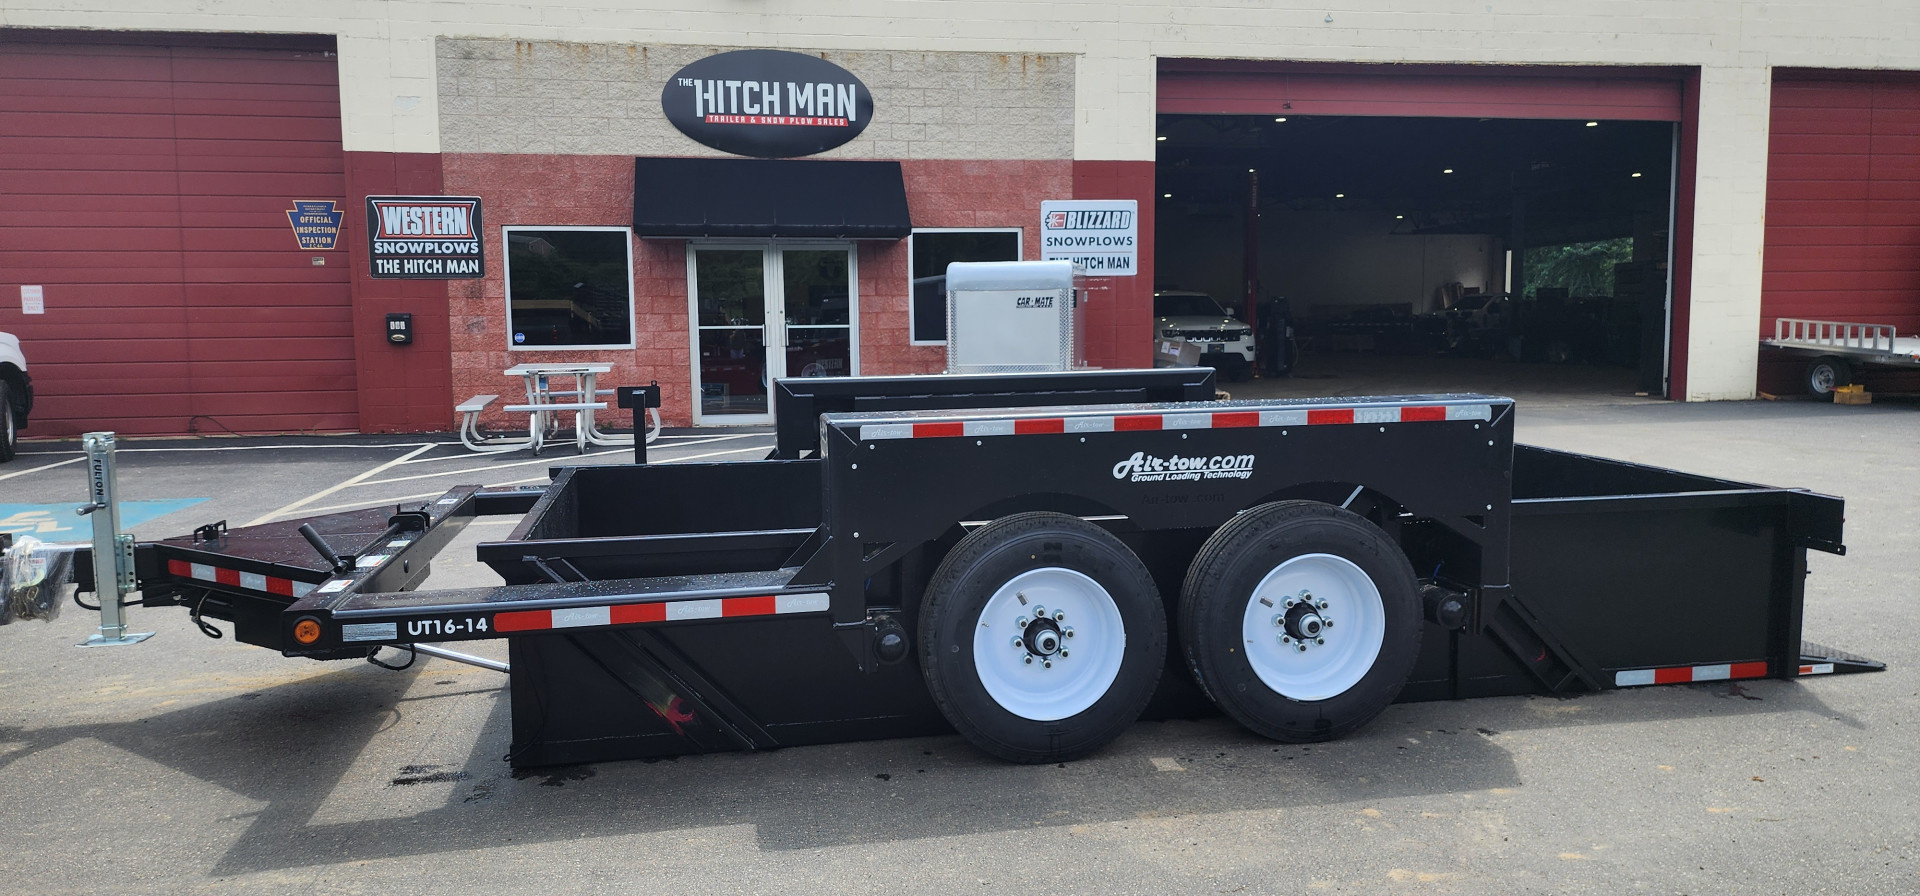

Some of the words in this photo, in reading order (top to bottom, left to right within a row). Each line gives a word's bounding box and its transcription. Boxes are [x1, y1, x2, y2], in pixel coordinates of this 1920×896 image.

[677, 78, 694, 87] THE
[694, 79, 781, 117] HITCH
[786, 82, 857, 122] MAN
[709, 115, 746, 123] TRAILER
[750, 115, 756, 123] &
[790, 117, 813, 125] PLOW
[817, 118, 845, 126] SALES
[300, 216, 333, 224] OFFICIAL
[382, 206, 468, 235] WESTERN
[1066, 211, 1131, 229] BLIZZARD
[296, 226, 337, 234] INSPECTION
[301, 236, 332, 244] STATION
[1046, 236, 1133, 247] SNOWPLOWS
[374, 242, 479, 254] SNOWPLOWS
[376, 259, 400, 274] THE
[404, 259, 442, 274] HITCH
[446, 259, 479, 274] MAN
[1107, 256, 1130, 269] MAN
[1112, 451, 1256, 480] Air-tow.com
[93, 459, 105, 496] FULTON
[1131, 473, 1164, 483] Ground
[1166, 472, 1201, 482] Loading
[1203, 470, 1253, 480] Technology
[407, 617, 489, 636] UT16-14
